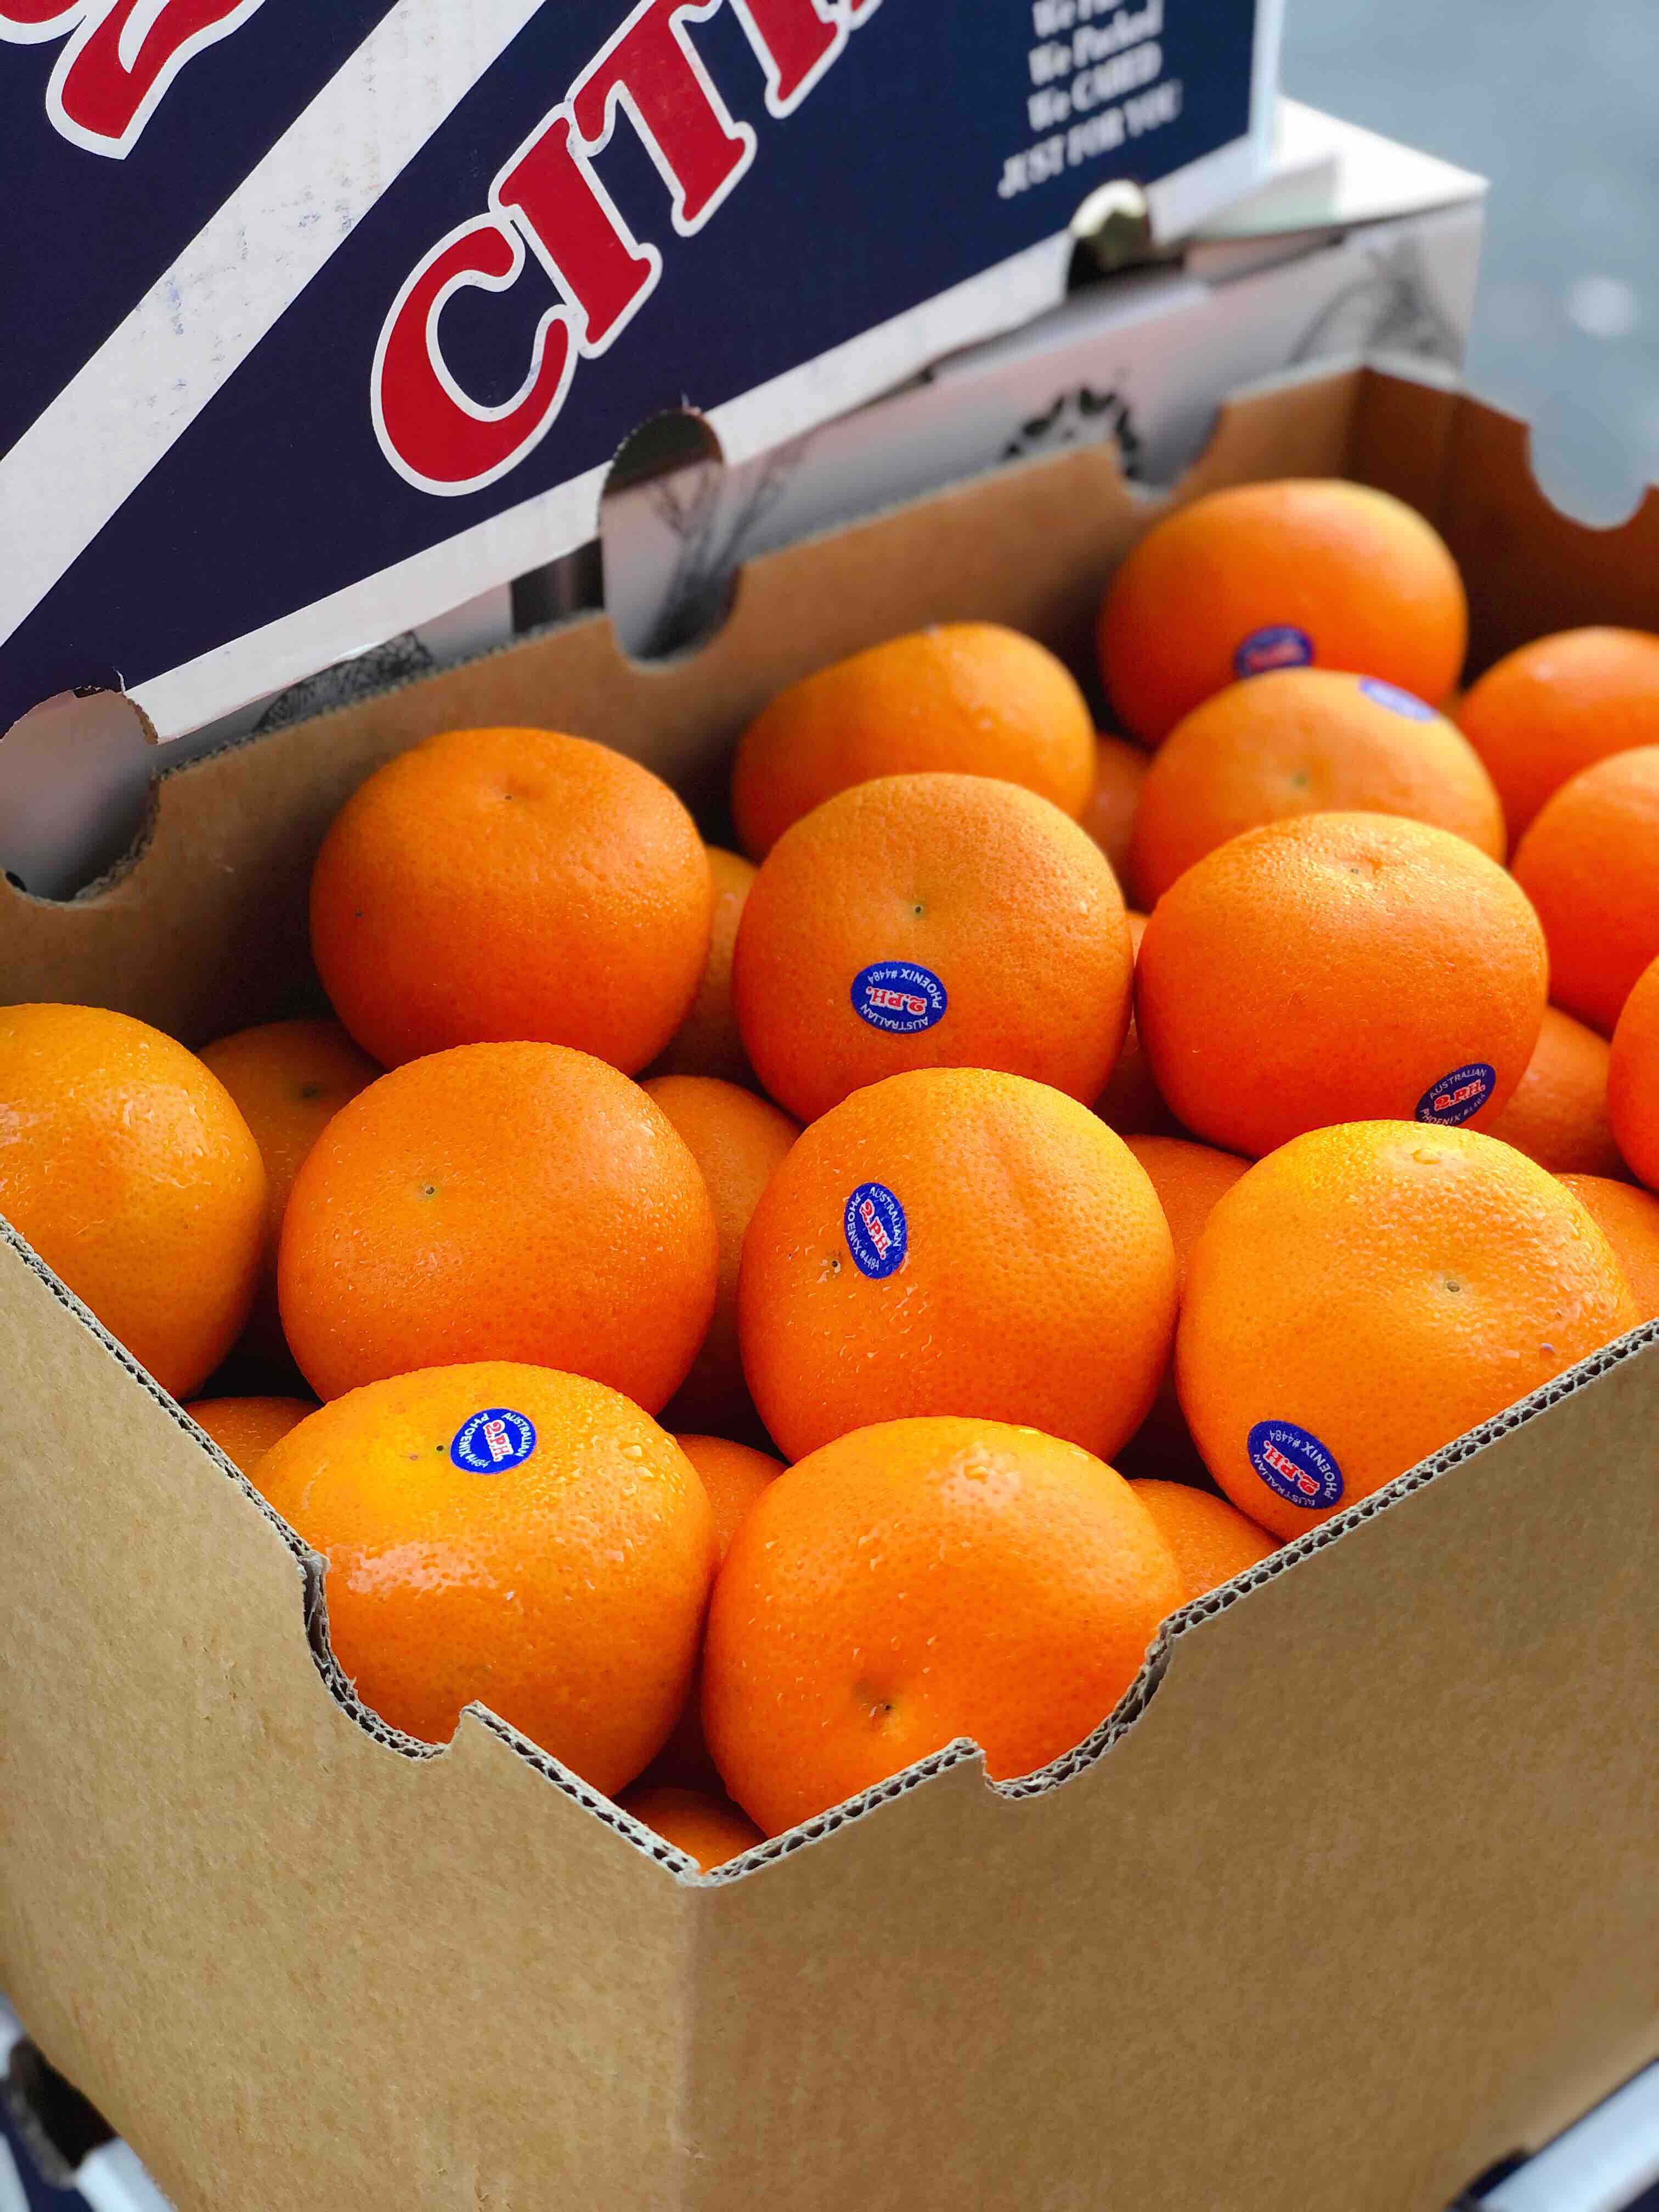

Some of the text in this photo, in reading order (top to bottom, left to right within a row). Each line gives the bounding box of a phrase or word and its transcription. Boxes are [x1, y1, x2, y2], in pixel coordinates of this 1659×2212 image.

[900, 968, 942, 1009] PHOENIX
[860, 1003, 929, 1031] AUSTRALIAN
[1430, 1068, 1487, 1100] AUSTRALIAN
[848, 1192, 862, 1255] PHOENIX
[869, 1186, 902, 1247] AUSTRALIAN
[459, 1413, 490, 1458] PHOENIX
[501, 1412, 533, 1457] AUSTRALIAN
[1253, 1454, 1316, 1506] AUSTRALIAN
[1301, 1441, 1338, 1500] PHOENIX
